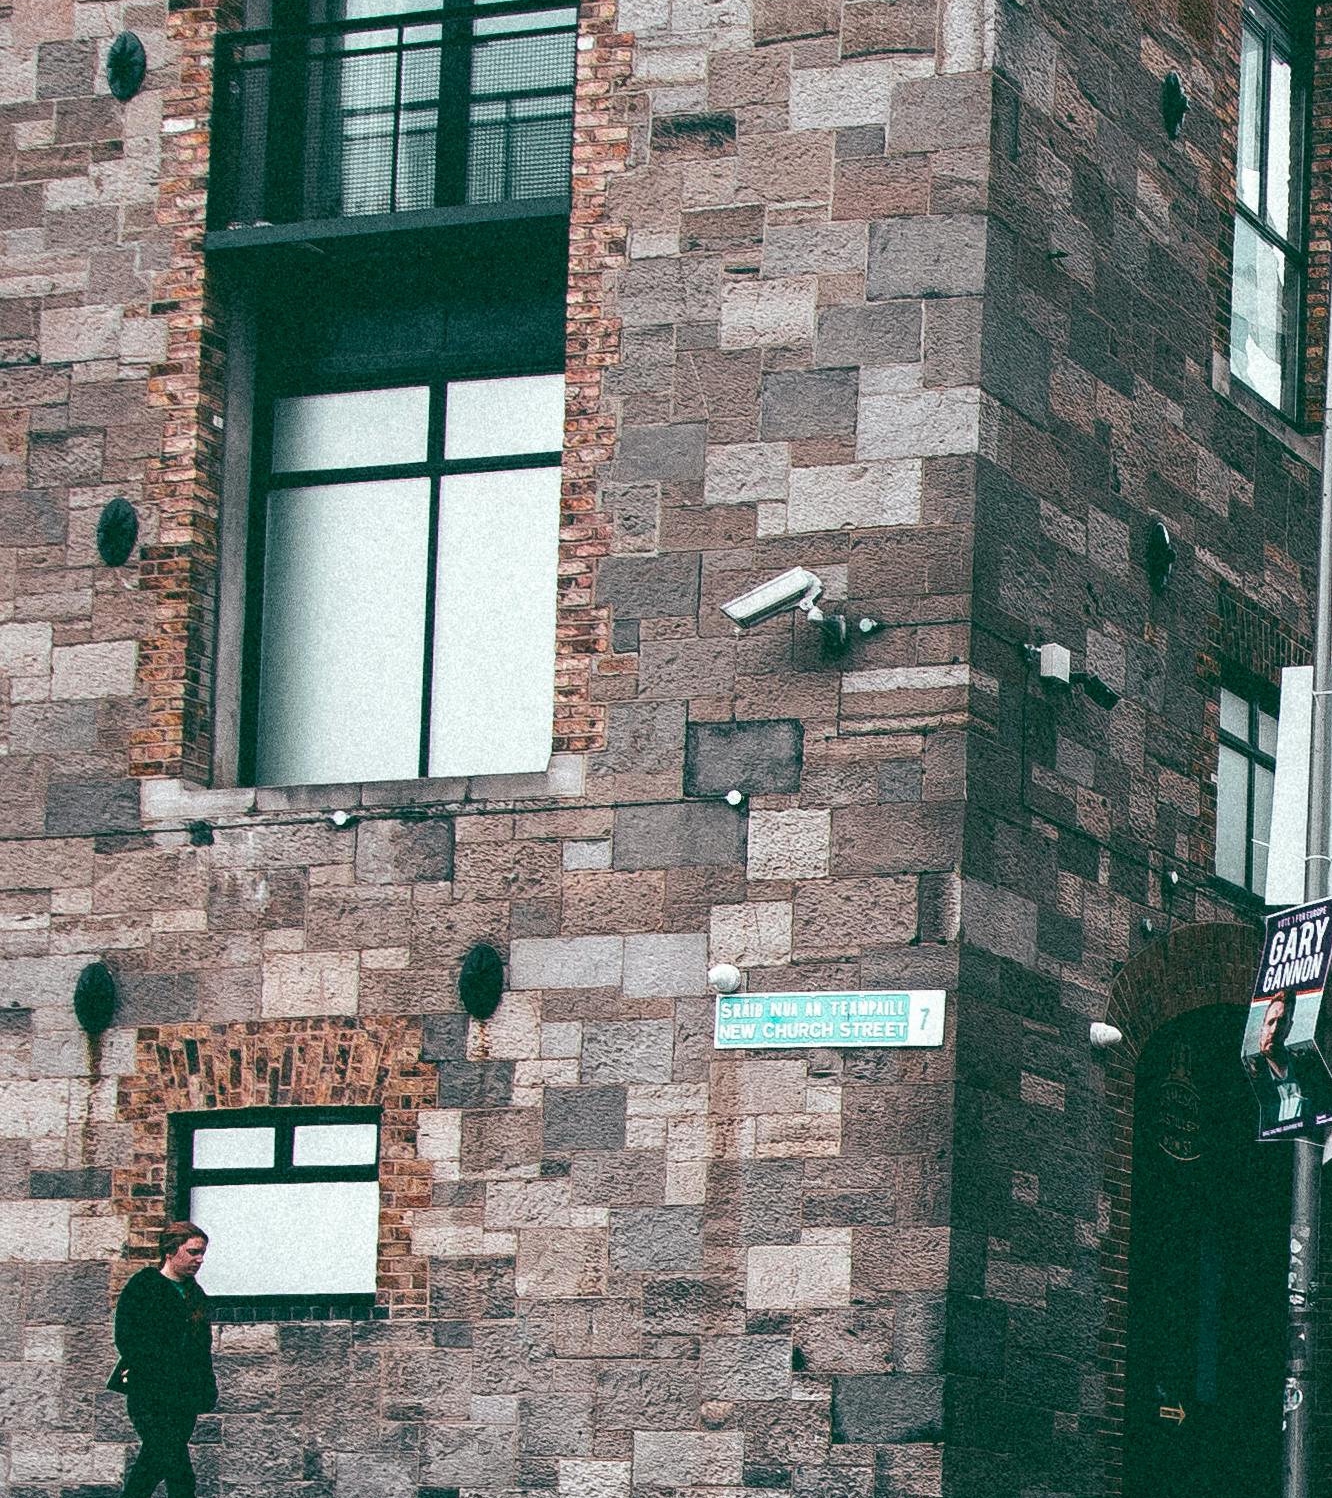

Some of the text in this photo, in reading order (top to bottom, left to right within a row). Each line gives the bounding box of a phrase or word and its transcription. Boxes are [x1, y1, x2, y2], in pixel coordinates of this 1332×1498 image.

[1306, 906, 1327, 919] EUROPE
[1269, 917, 1330, 966] GARY
[1262, 952, 1324, 993] GANNON
[770, 1002, 798, 1017] NUA
[805, 1001, 822, 1017] AN
[831, 999, 905, 1016] TEAMPAILL
[920, 1007, 931, 1031] 7
[719, 1021, 908, 1040] NEW CHURCH STREET
